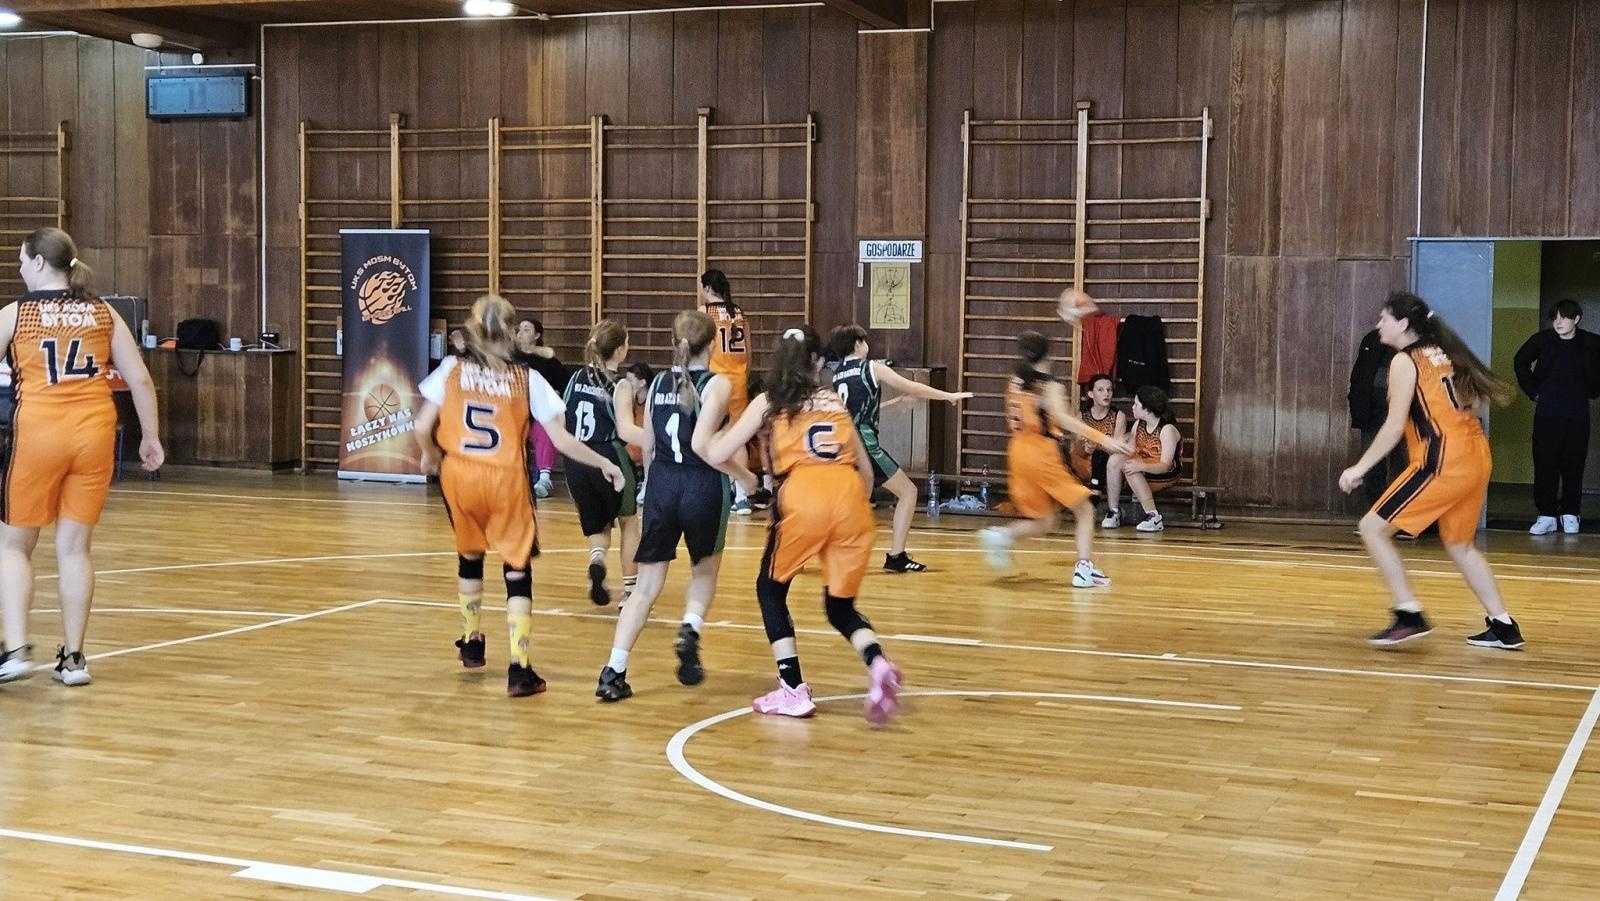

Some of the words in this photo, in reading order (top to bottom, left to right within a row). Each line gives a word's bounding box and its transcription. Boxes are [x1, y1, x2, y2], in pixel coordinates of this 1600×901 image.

[866, 243, 915, 257] GOSPODARZE
[350, 267, 364, 290] UKS
[363, 255, 392, 269] MOSM
[392, 257, 418, 291] BYTOM
[41, 312, 98, 328] BYTOM
[719, 325, 746, 354] 12
[39, 337, 101, 385] 14
[345, 420, 417, 452] KOSZYKÓWK
[350, 416, 386, 437] ŁĄCZY
[388, 408, 412, 424] NAS
[460, 399, 502, 454] 5
[574, 400, 596, 442] 13
[665, 412, 683, 463] 1
